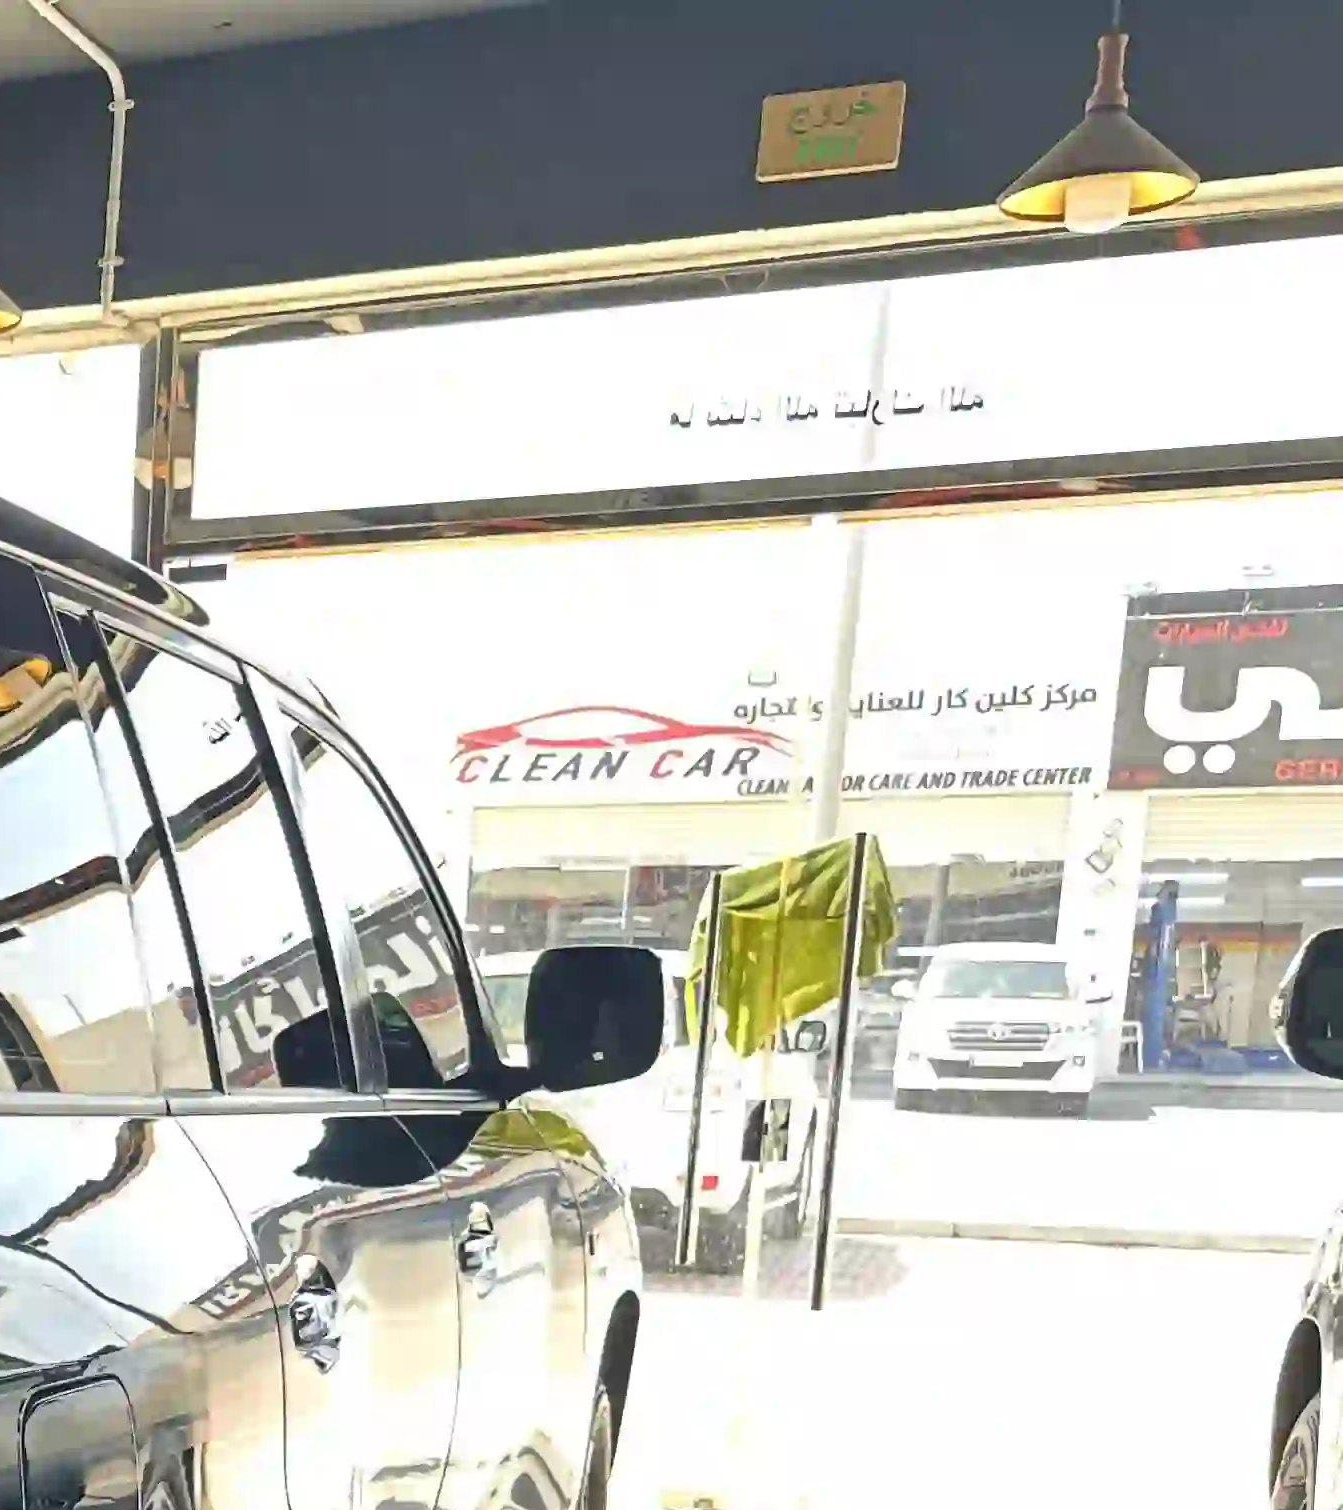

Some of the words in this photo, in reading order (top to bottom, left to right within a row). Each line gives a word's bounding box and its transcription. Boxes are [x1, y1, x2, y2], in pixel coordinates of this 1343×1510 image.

[931, 688, 968, 717] كار
[974, 684, 1035, 715] كلين
[1040, 682, 1097, 712] مركز
[455, 750, 632, 784] CLEAN
[648, 746, 761, 780] CAR
[737, 777, 790, 797] CLEAN
[868, 773, 915, 792] CARE
[917, 771, 956, 790] AND
[961, 769, 1018, 789] TRADE
[1023, 766, 1093, 786] CENTER
